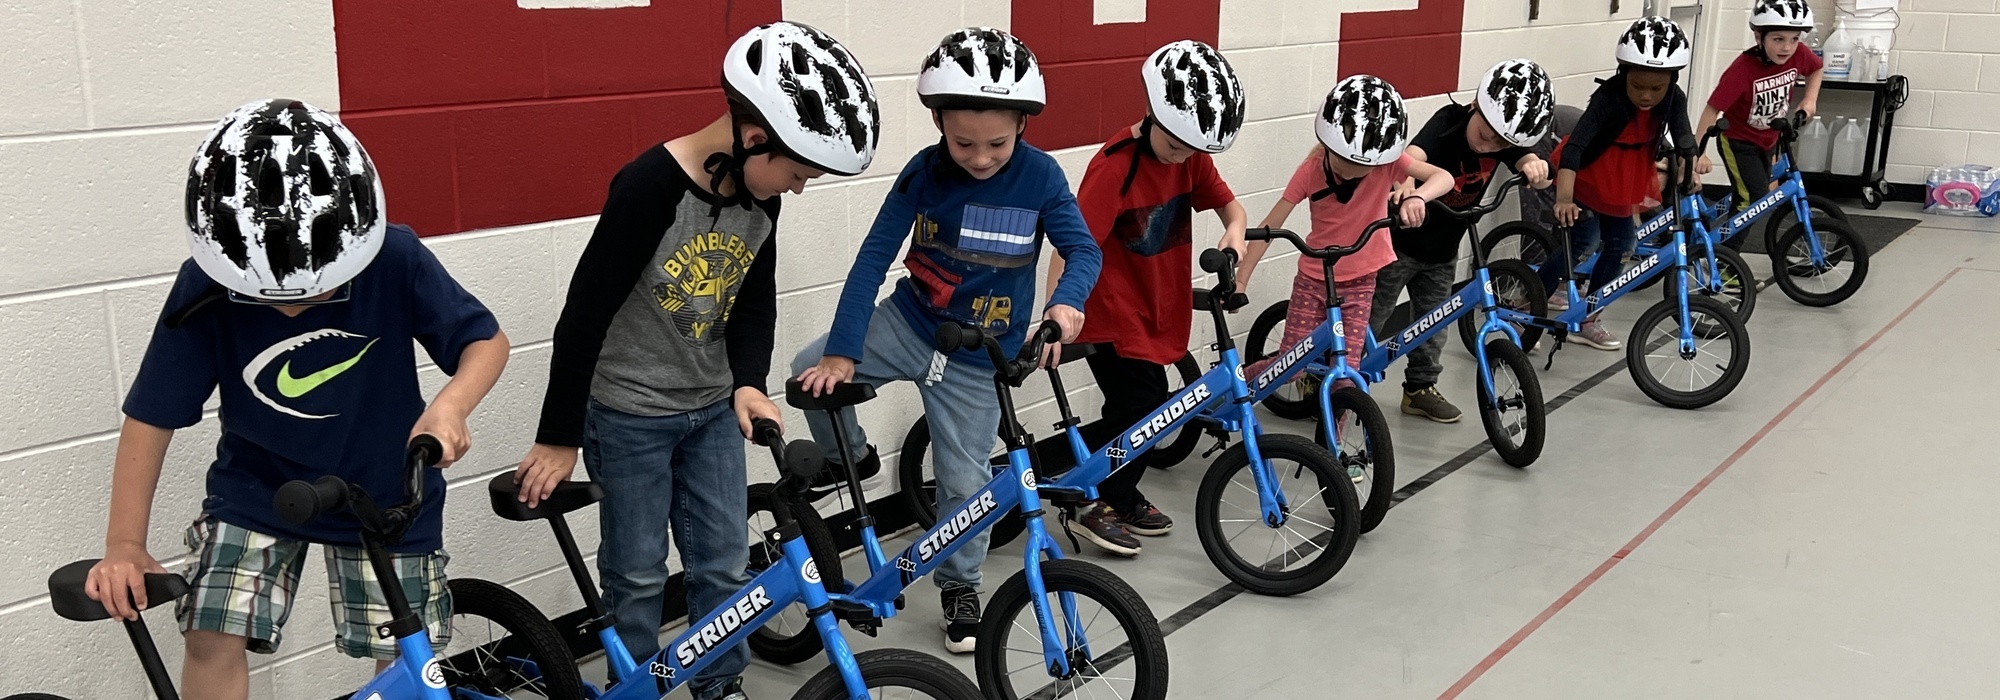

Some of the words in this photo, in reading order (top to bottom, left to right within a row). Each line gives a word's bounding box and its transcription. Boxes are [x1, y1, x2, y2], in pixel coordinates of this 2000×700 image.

[1755, 71, 1796, 92] WARNING
[1756, 86, 1788, 106] NINJ
[1635, 209, 1674, 240] RIDER
[1733, 190, 1785, 228] STRIDER
[663, 231, 756, 279] BUMBLEBE
[1603, 254, 1659, 298] STRIDER
[1403, 295, 1464, 344] STRIDER
[1258, 336, 1316, 390] STRIDER
[1105, 446, 1127, 459] 14x
[1130, 383, 1212, 449] STRIDER
[895, 557, 917, 572] 14x
[918, 489, 998, 563] STRIDER
[649, 661, 676, 679] 14x
[676, 585, 773, 669] STRIDER
